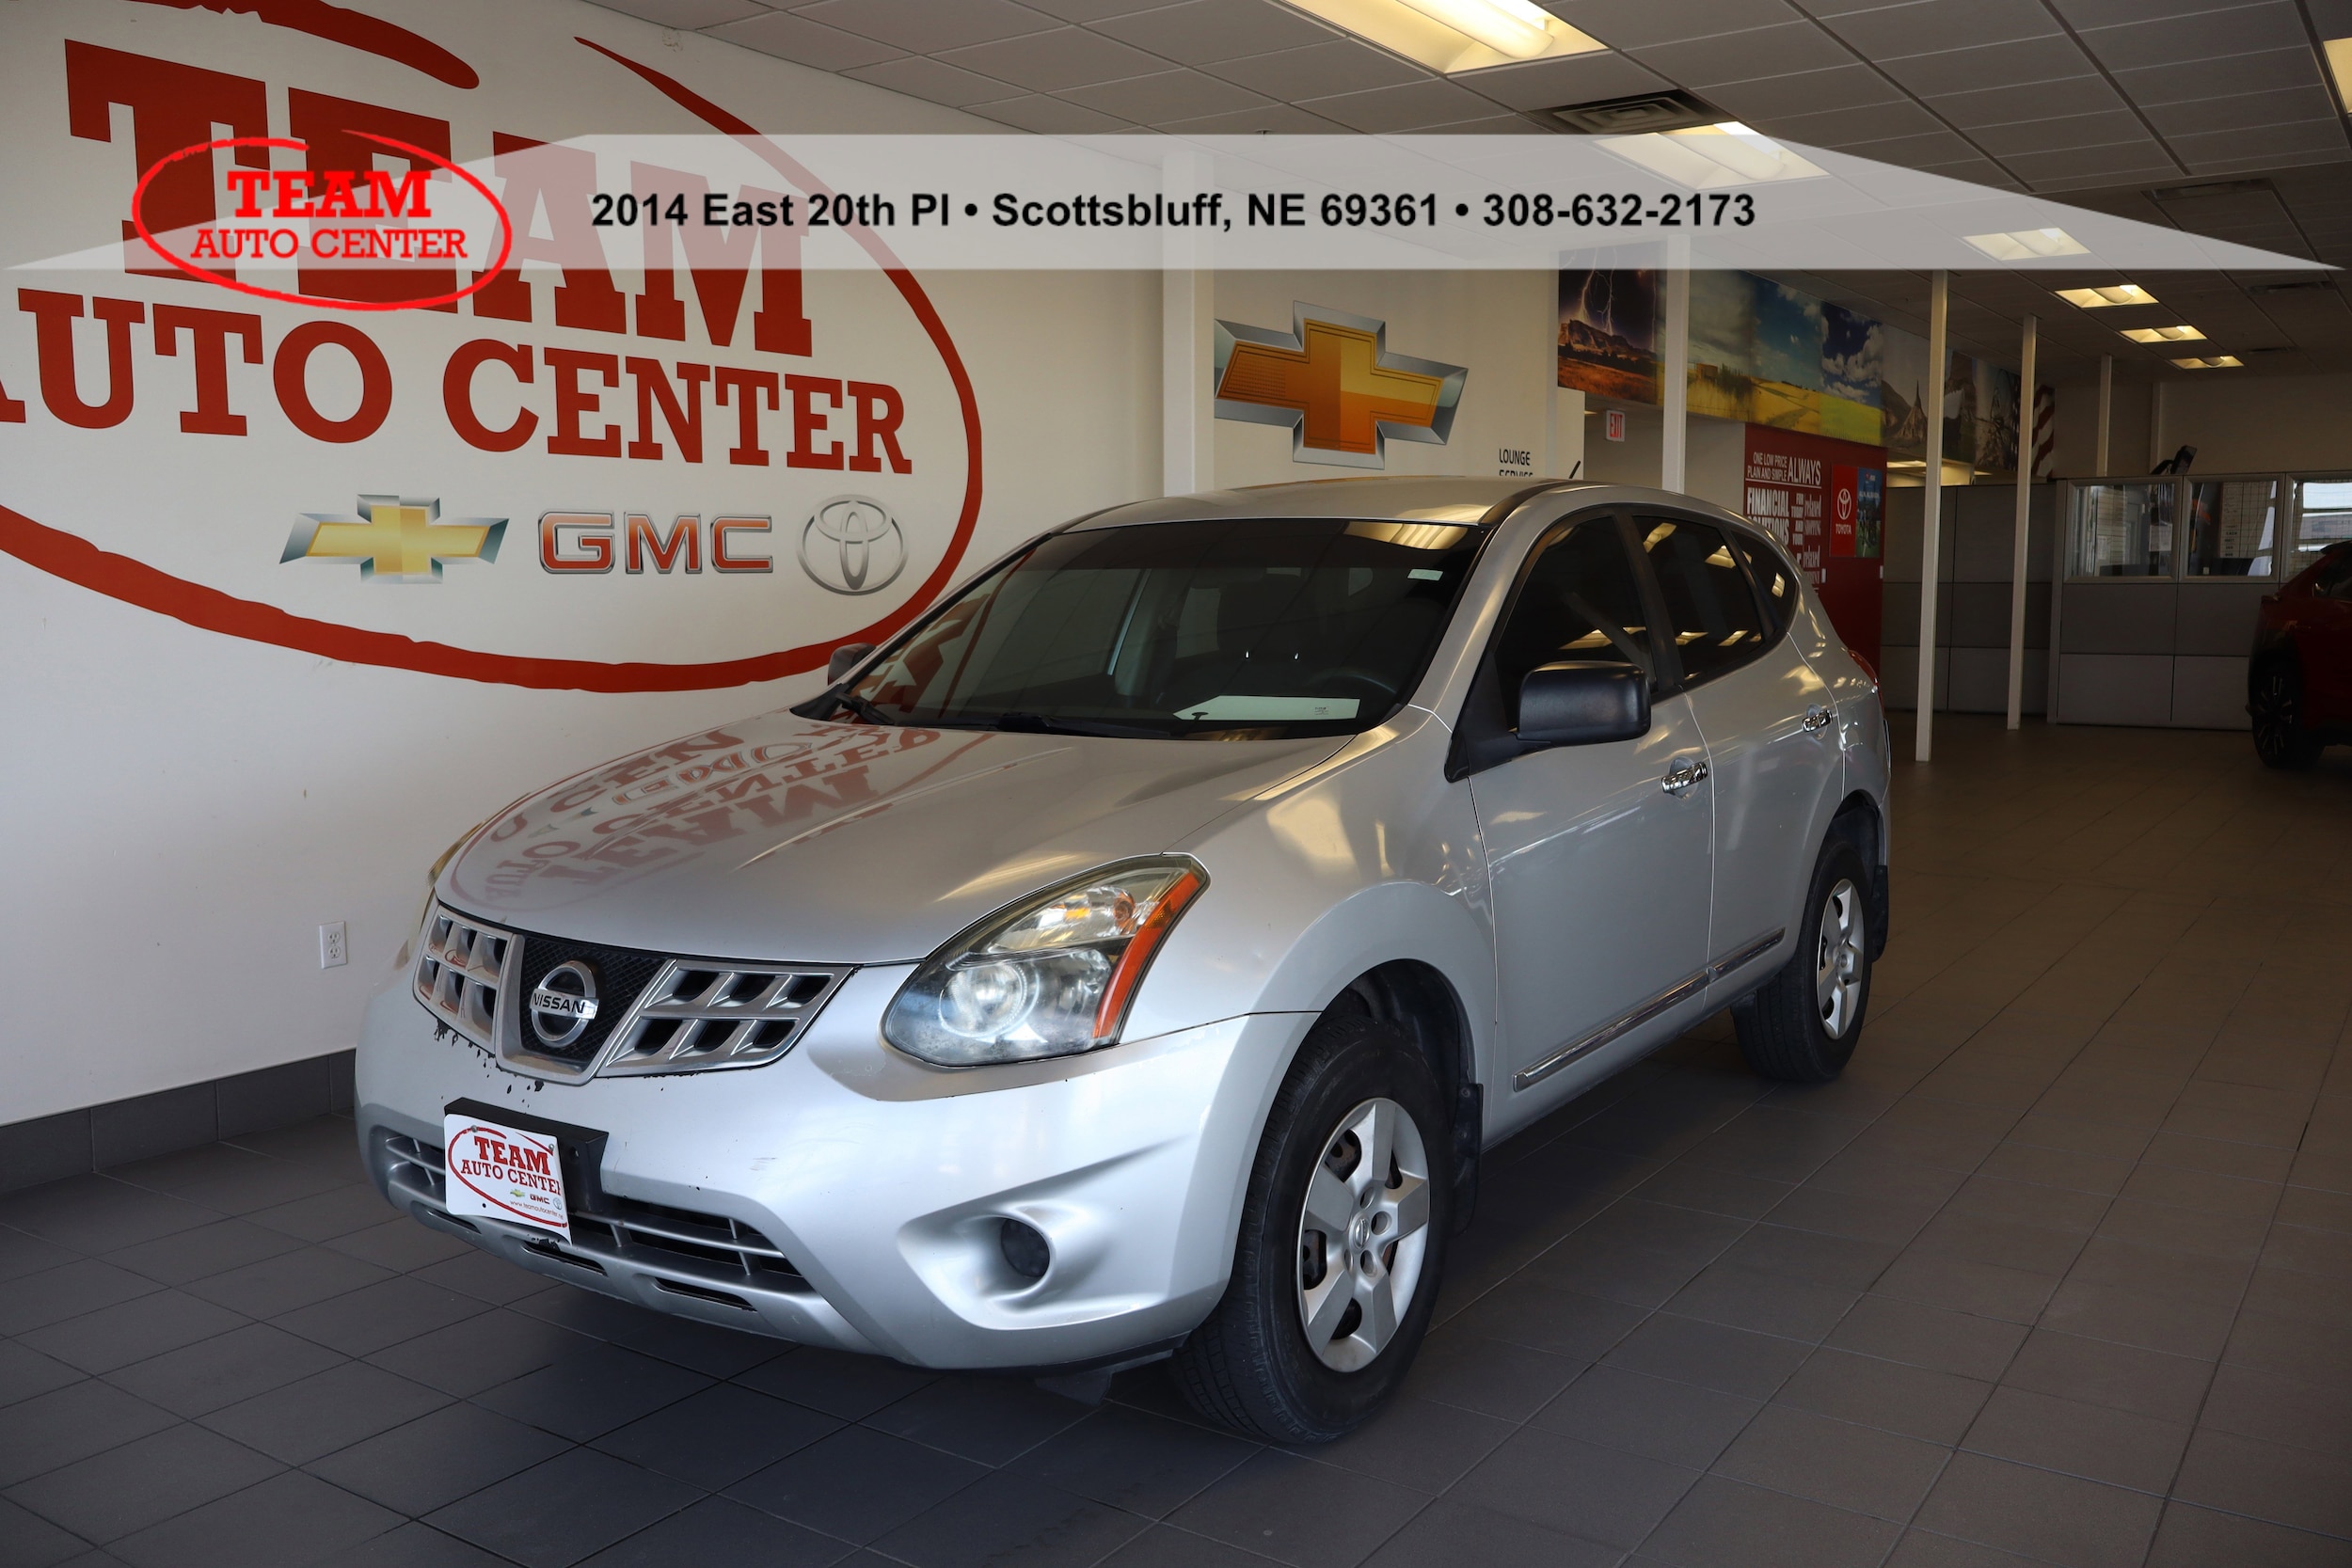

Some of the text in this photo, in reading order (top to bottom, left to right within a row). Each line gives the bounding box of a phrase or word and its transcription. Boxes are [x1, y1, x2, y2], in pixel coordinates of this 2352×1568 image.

[65, 39, 813, 358] TEAM
[0, 288, 912, 474] UTO CENTER
[1610, 413, 1623, 438] EXIT
[1499, 448, 1531, 467] LOUNGE
[1753, 451, 1788, 468] ONE LOW PRICE
[1747, 465, 1788, 482] PLAIN AND SIMPLE
[1788, 456, 1821, 486] ALWAYS
[1747, 486, 1789, 517] FINANCIAL
[1836, 523, 1852, 535] TOYOTA
[537, 509, 773, 576] GMC
[532, 992, 585, 1014] NISSAN
[474, 1135, 551, 1176] TEAM
[460, 1159, 504, 1180] AUTO
[530, 1194, 550, 1205] GMC
